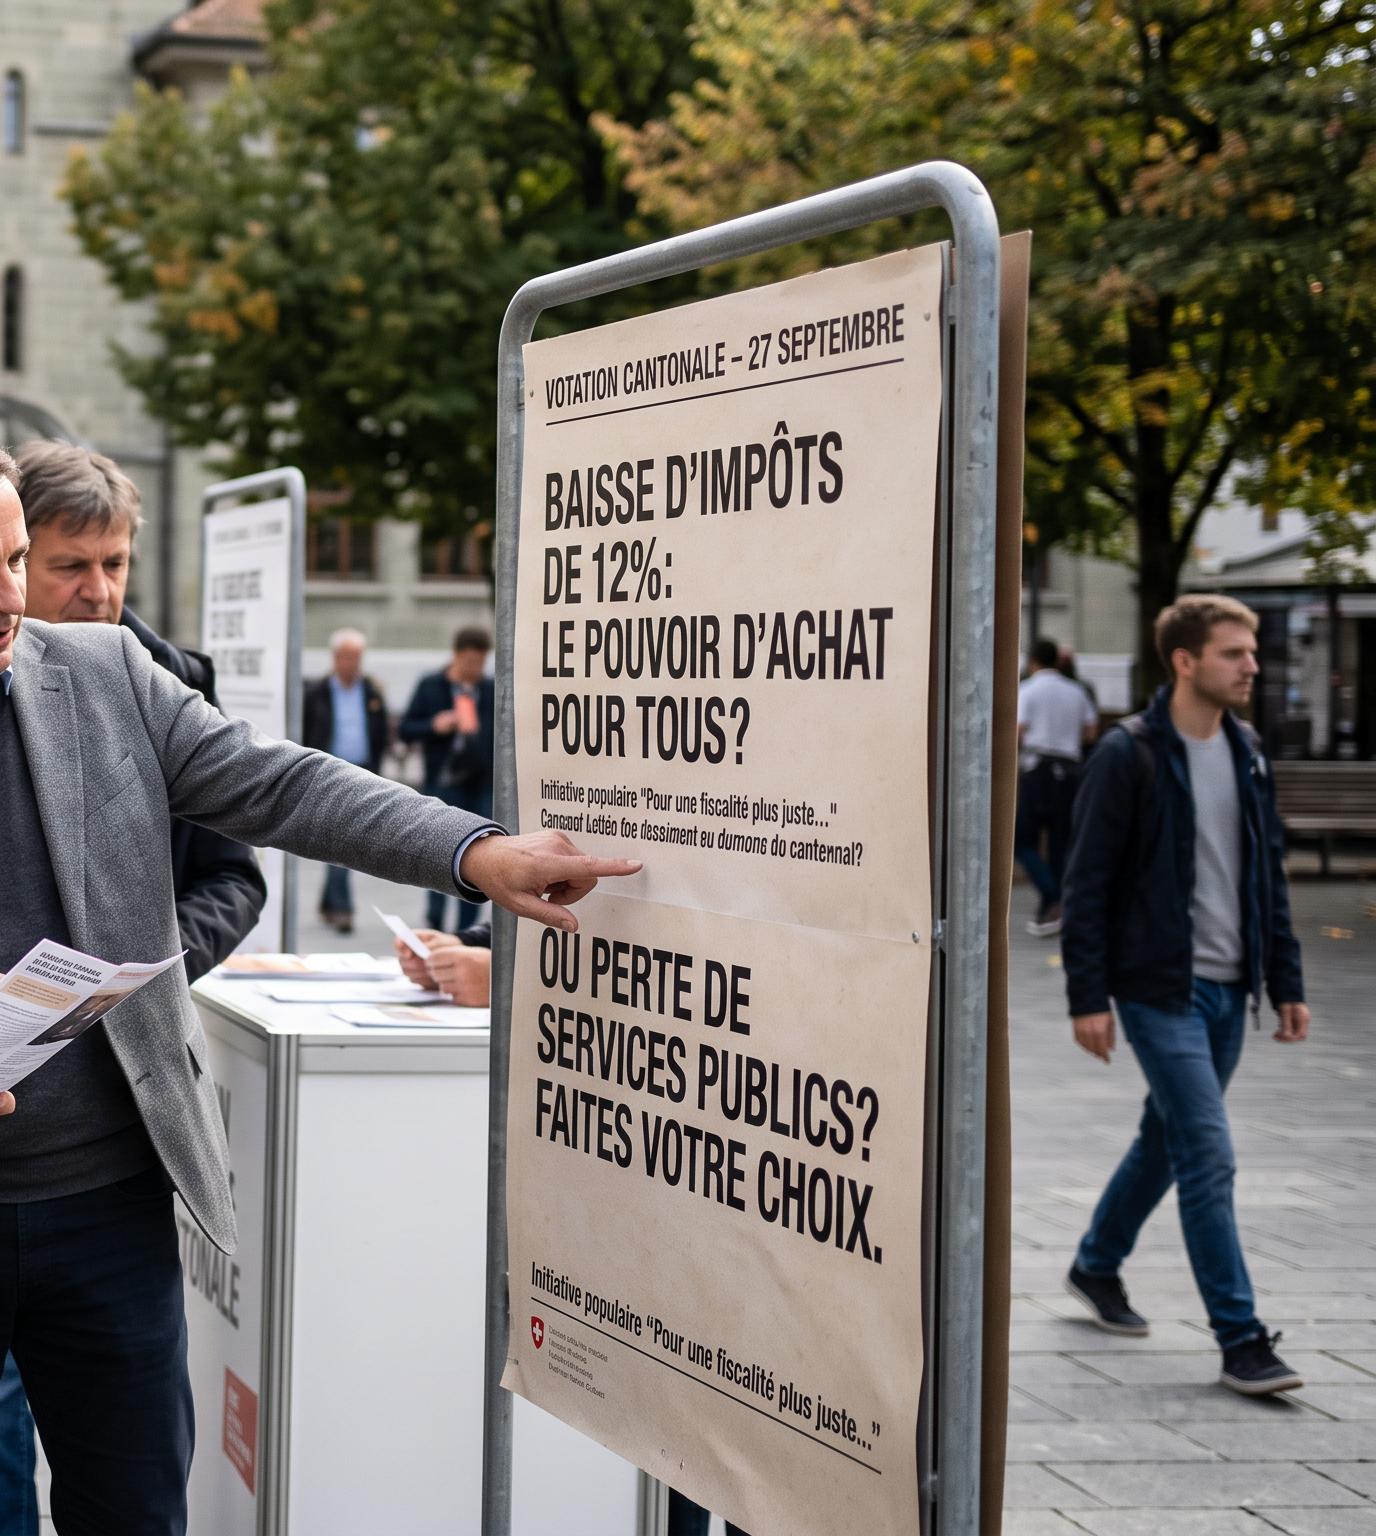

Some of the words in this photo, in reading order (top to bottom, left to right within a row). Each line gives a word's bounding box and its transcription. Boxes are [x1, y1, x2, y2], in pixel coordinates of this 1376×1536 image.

[546, 366, 617, 409] VOTATION
[624, 342, 725, 394] CANTONALE
[749, 333, 771, 370] 27
[778, 304, 904, 364] SEPTEMBRE
[546, 459, 654, 531] BAISSE
[666, 420, 843, 518] D’IMPÔTS
[544, 545, 581, 604] DE
[593, 537, 671, 602] 12%:
[543, 621, 574, 677] LE
[585, 615, 720, 679] POUVOIR
[733, 607, 893, 680] D’ACHAT
[543, 694, 625, 757] POUR
[636, 696, 750, 764] TOUS?
[541, 779, 584, 803] Initiative
[588, 787, 637, 809] populaire
[641, 788, 672, 811] "Pour
[676, 796, 696, 814] une
[700, 792, 748, 819] fiscalité
[753, 798, 778, 825] plus
[540, 927, 580, 993] OU
[591, 937, 692, 1021] PERTE
[705, 960, 751, 1035] DE
[538, 1003, 686, 1103] SERVICES
[698, 1044, 878, 1162] PUBLICS?
[536, 1078, 632, 1168] FAITES
[642, 1111, 746, 1212] VOTRE
[758, 1151, 882, 1264] CHOIX.
[176, 1216, 240, 1330] TONALE
[532, 1262, 581, 1306] Initiative
[585, 1292, 641, 1336] populaire
[647, 1315, 684, 1354] “Pour
[688, 1341, 712, 1370] une
[717, 1348, 774, 1400] fiscalité
[779, 1383, 811, 1419] plus
